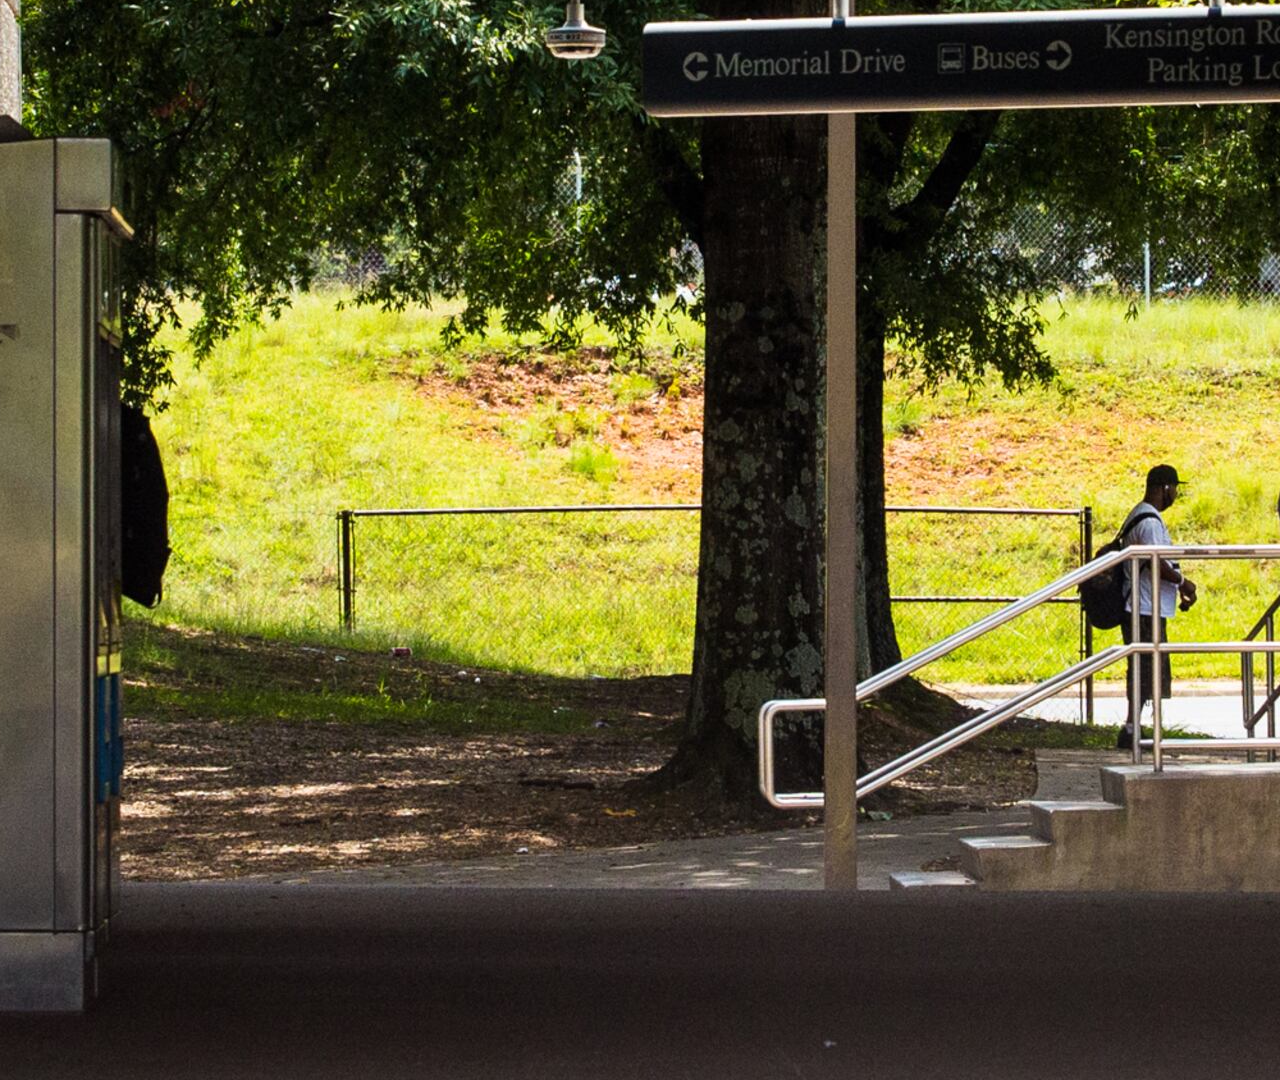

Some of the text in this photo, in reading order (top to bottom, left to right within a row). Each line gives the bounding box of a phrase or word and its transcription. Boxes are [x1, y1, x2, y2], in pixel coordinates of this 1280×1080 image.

[1104, 22, 1246, 52] Kensington
[714, 48, 906, 79] Memorial Drive
[972, 45, 1040, 71] Buses
[1147, 56, 1244, 86] Parking
